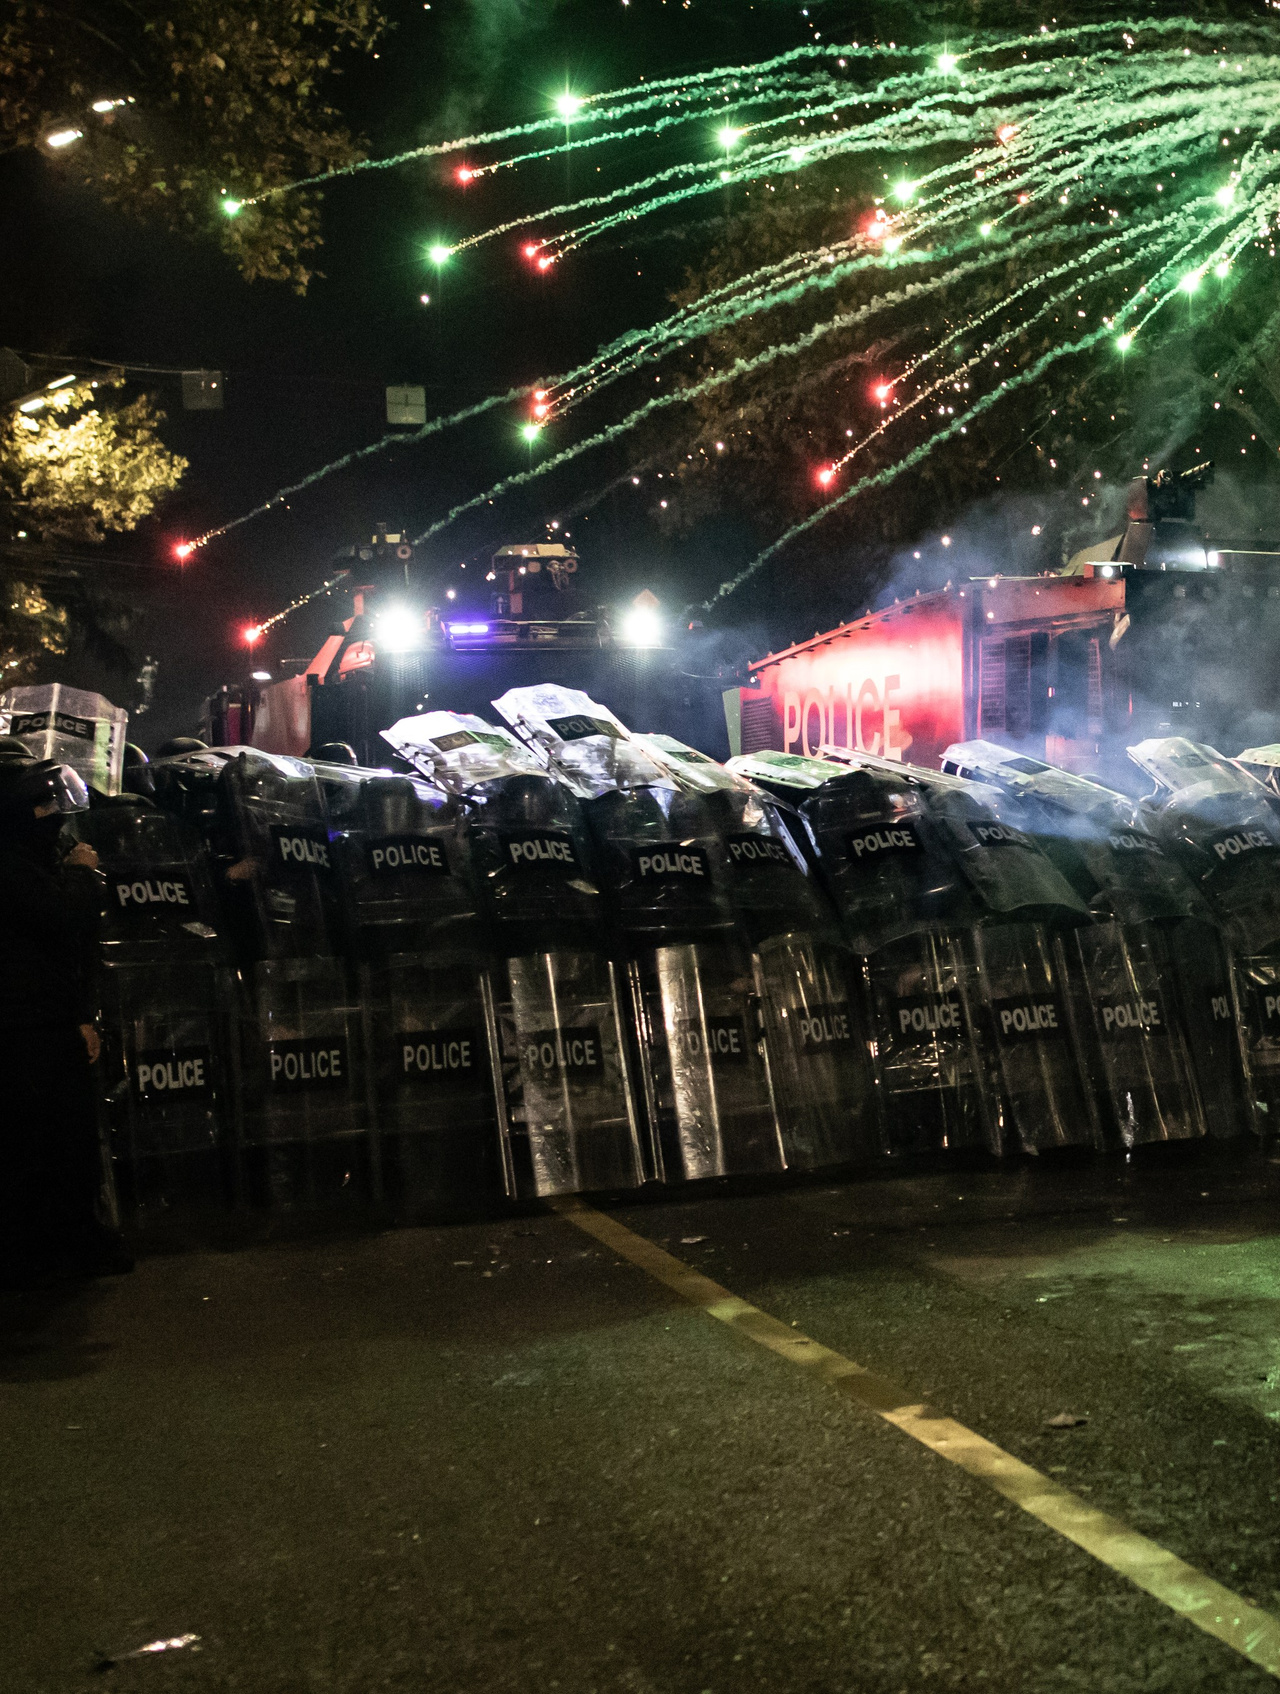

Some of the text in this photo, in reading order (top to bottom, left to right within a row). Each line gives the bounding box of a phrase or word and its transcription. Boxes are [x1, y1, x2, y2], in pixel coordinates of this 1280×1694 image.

[784, 674, 902, 761] POLICE
[280, 836, 331, 869] POLICE
[372, 843, 443, 870] POLICE
[509, 839, 575, 865] POLICE
[730, 839, 789, 864] POLICE
[852, 830, 917, 857] POLICE
[1213, 830, 1273, 860] POLICE
[638, 852, 705, 877] POLICE
[116, 879, 190, 907] POLICE
[800, 1014, 850, 1045] POLICE
[900, 1002, 961, 1034] POLICE
[1001, 1003, 1058, 1035] POLICE
[1102, 1001, 1161, 1031] POLICE
[271, 1049, 342, 1081] POLICE
[403, 1040, 472, 1072] POLICE
[138, 1058, 205, 1093] POLICE
